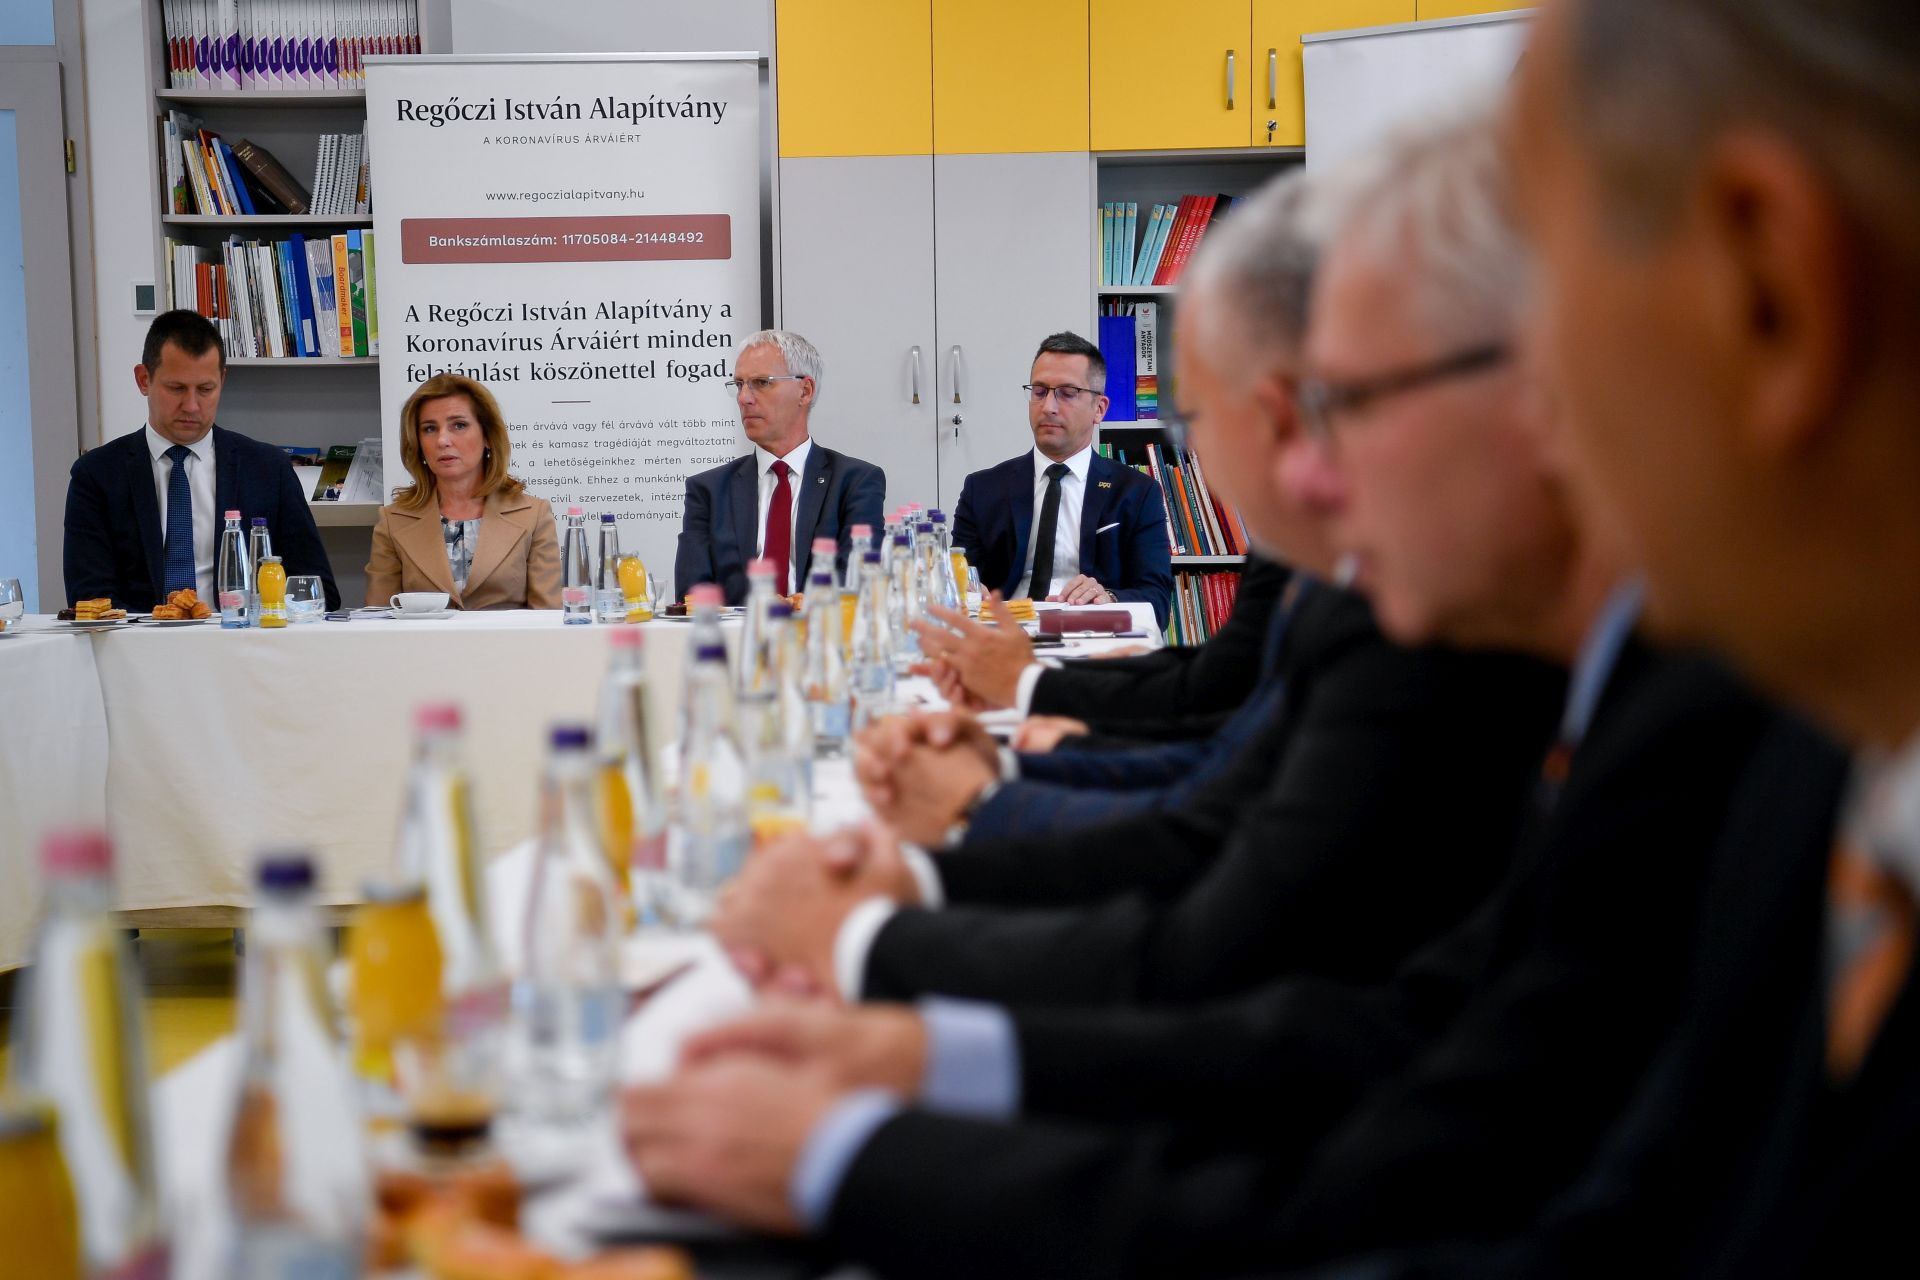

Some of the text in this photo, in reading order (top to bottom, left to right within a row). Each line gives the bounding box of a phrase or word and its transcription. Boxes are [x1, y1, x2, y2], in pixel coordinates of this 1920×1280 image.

[397, 93, 728, 128] Regőczi István Alapítvány
[483, 132, 641, 145] A KORONAVÍRUS ÁRVÁIÉRT
[485, 188, 645, 203] www.regoczialapitvany.hu
[429, 231, 704, 247] Bankszámlaszám: 11705084-21448492
[338, 267, 348, 317] Boardmaker
[404, 298, 733, 328] A Regőczi István Alapítvány a
[406, 327, 733, 353] Koronavírus Árváiért minden
[1146, 330, 1154, 372] MÓDSZERTANI
[530, 359, 656, 381] köszönettel
[666, 358, 733, 384] fogad.
[533, 421, 568, 431] árvává
[572, 423, 597, 433] vagy
[601, 420, 615, 430] fél
[618, 419, 654, 429] árvává
[658, 419, 679, 429] vált
[682, 418, 707, 428] több
[711, 418, 736, 428] mint
[531, 439, 544, 449] és
[548, 439, 589, 449] kamasz
[593, 437, 652, 450] tragédiáját
[656, 436, 736, 449] megváltoztatni
[644, 455, 682, 465] mérten
[587, 475, 619, 485] Ehhez
[550, 493, 572, 503] civil
[578, 492, 644, 503] szervezetek,
[616, 510, 682, 522] adományait.
